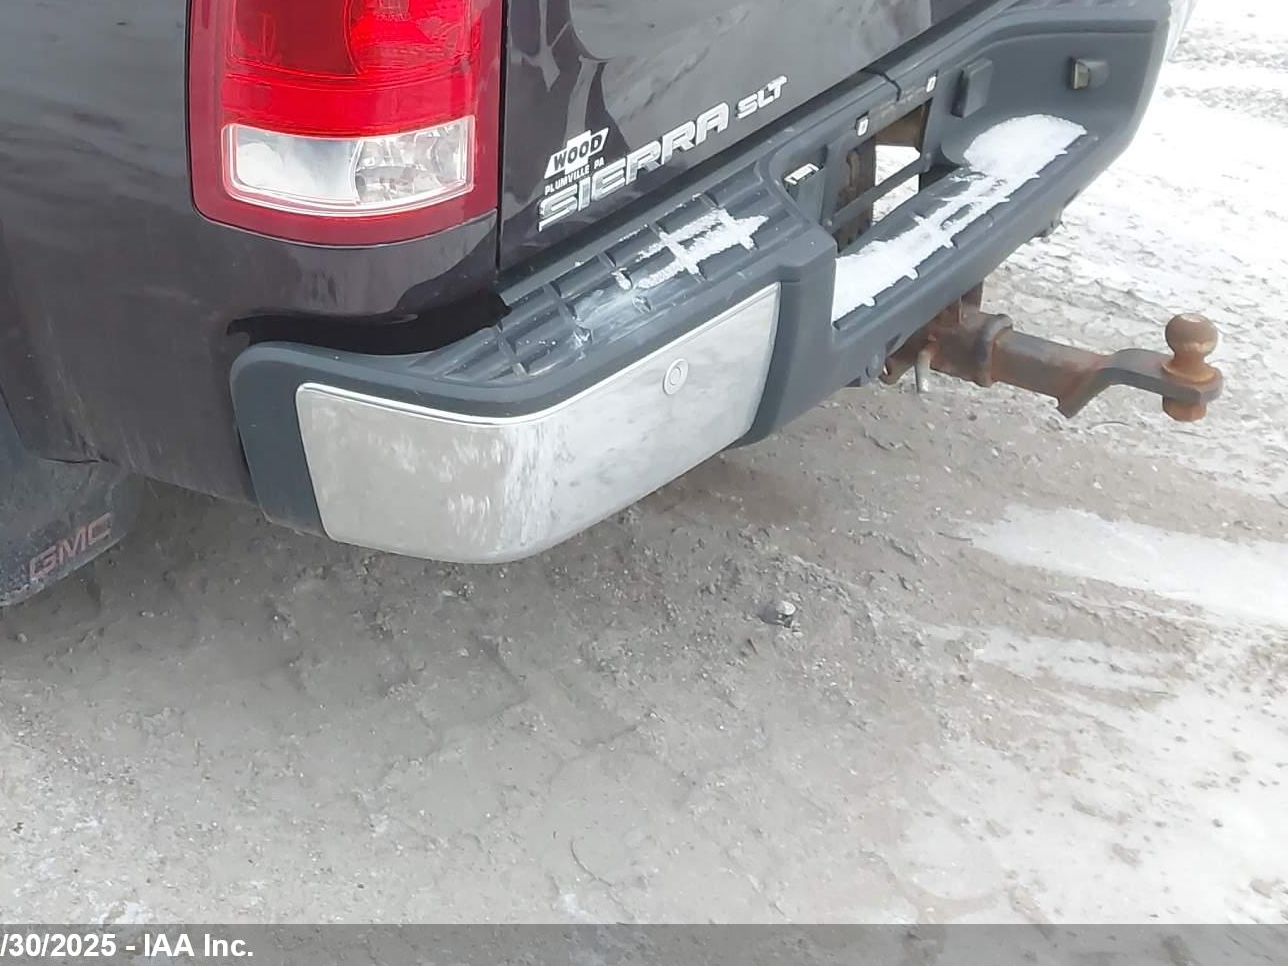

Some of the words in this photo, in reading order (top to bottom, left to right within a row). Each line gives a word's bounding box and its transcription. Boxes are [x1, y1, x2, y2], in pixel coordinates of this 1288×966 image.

[537, 101, 730, 233] SIERRA
[735, 75, 788, 120] SLT
[544, 164, 591, 196] PLUMVILLE
[593, 156, 605, 170] PA
[553, 134, 603, 172] WOOD
[29, 512, 112, 581] GMC
